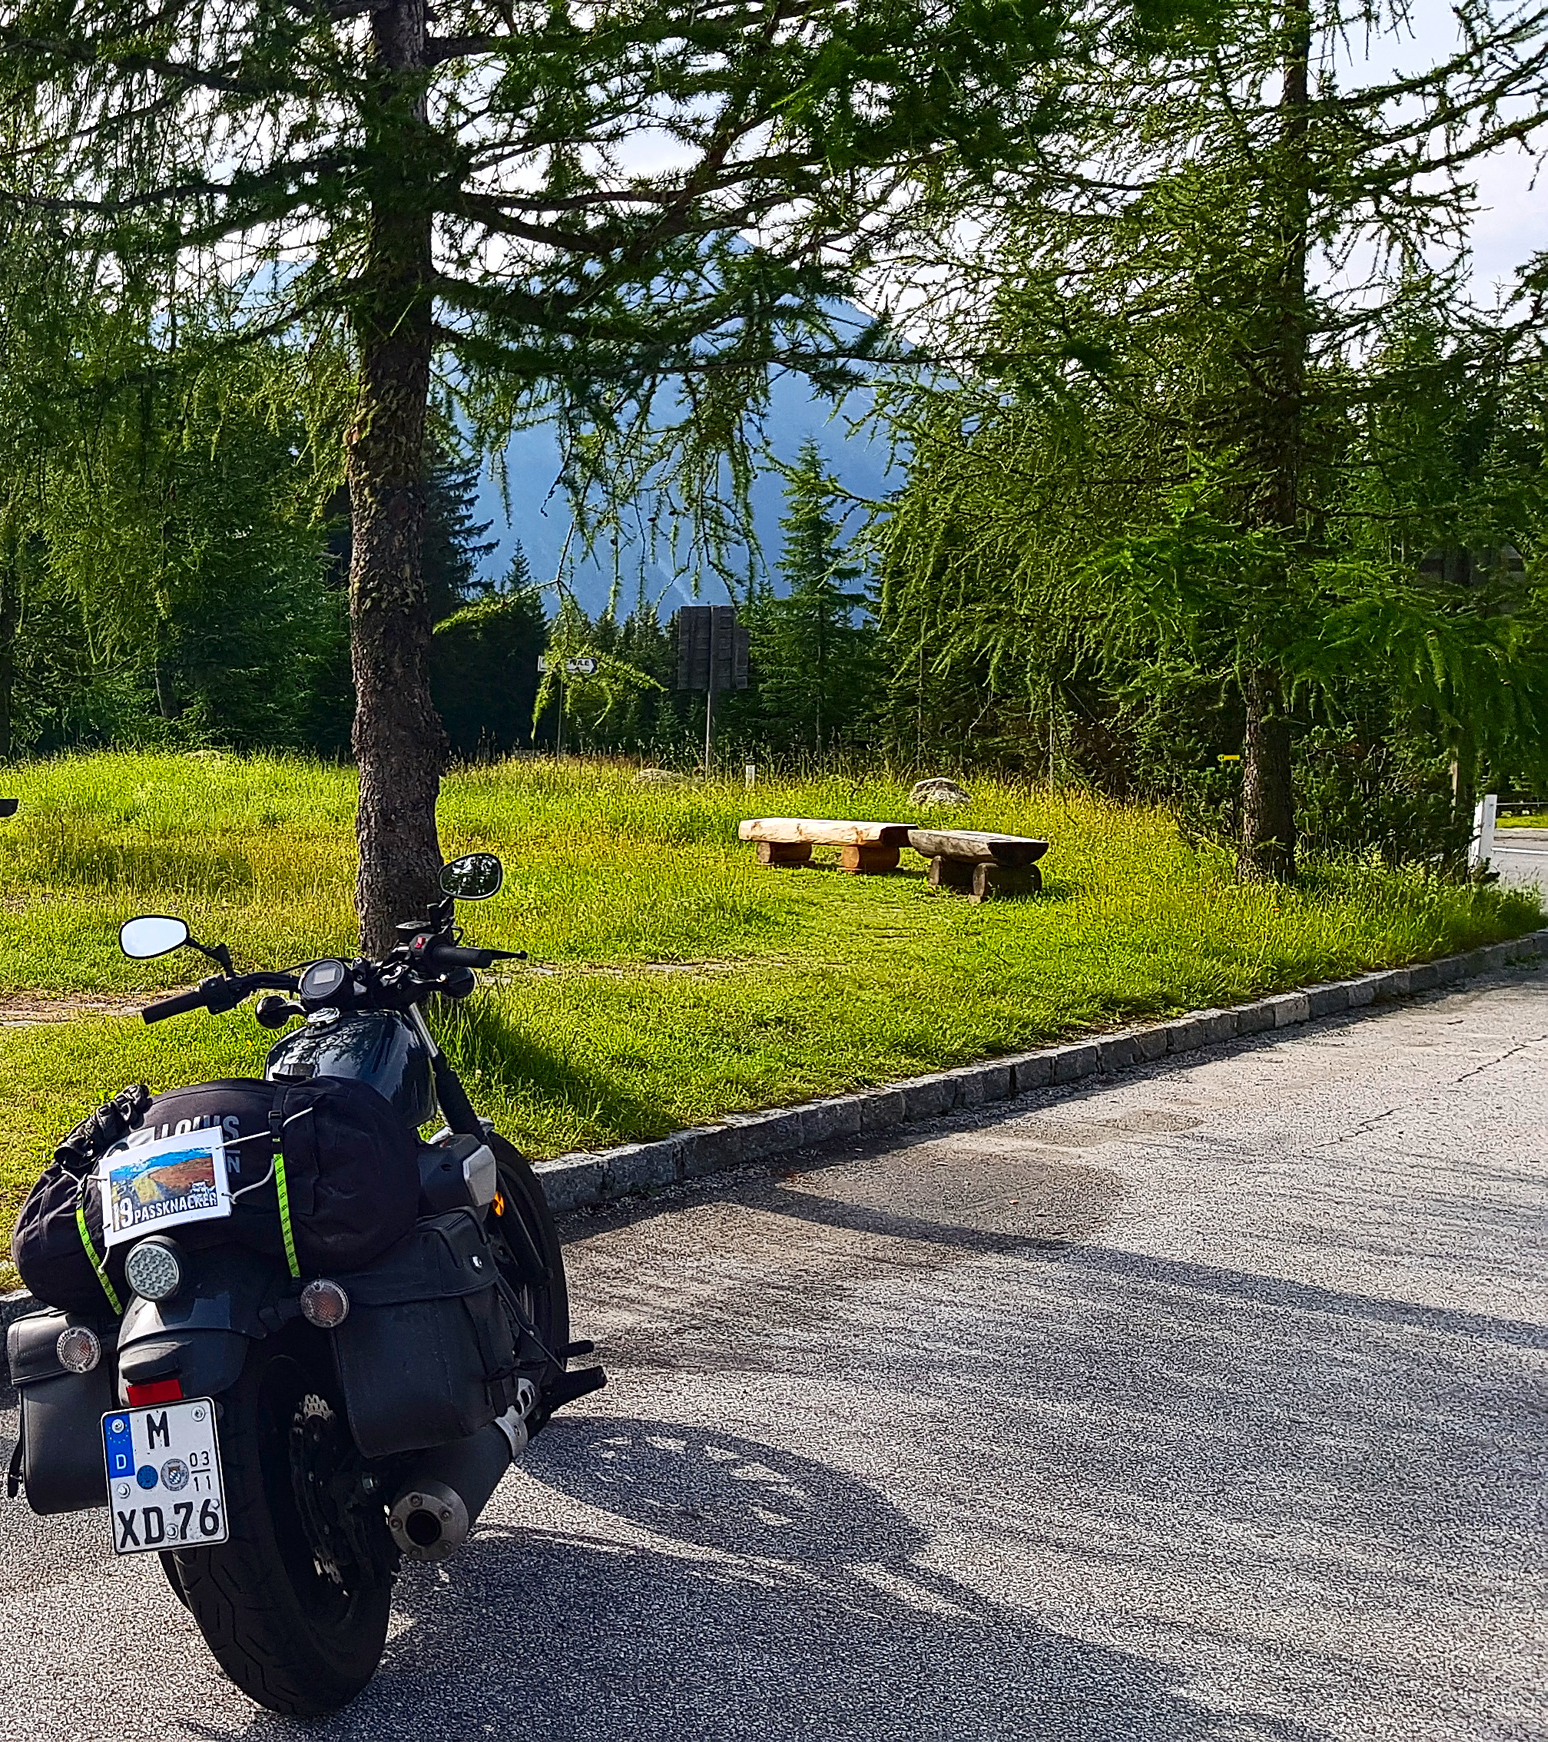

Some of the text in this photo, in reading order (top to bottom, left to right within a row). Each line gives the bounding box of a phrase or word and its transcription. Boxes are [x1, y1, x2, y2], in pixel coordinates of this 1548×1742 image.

[112, 1191, 218, 1231] 19 PASSKNACKER
[146, 1410, 170, 1450] M
[115, 1453, 127, 1470] D
[189, 1450, 210, 1468] 03
[193, 1475, 211, 1492] 11
